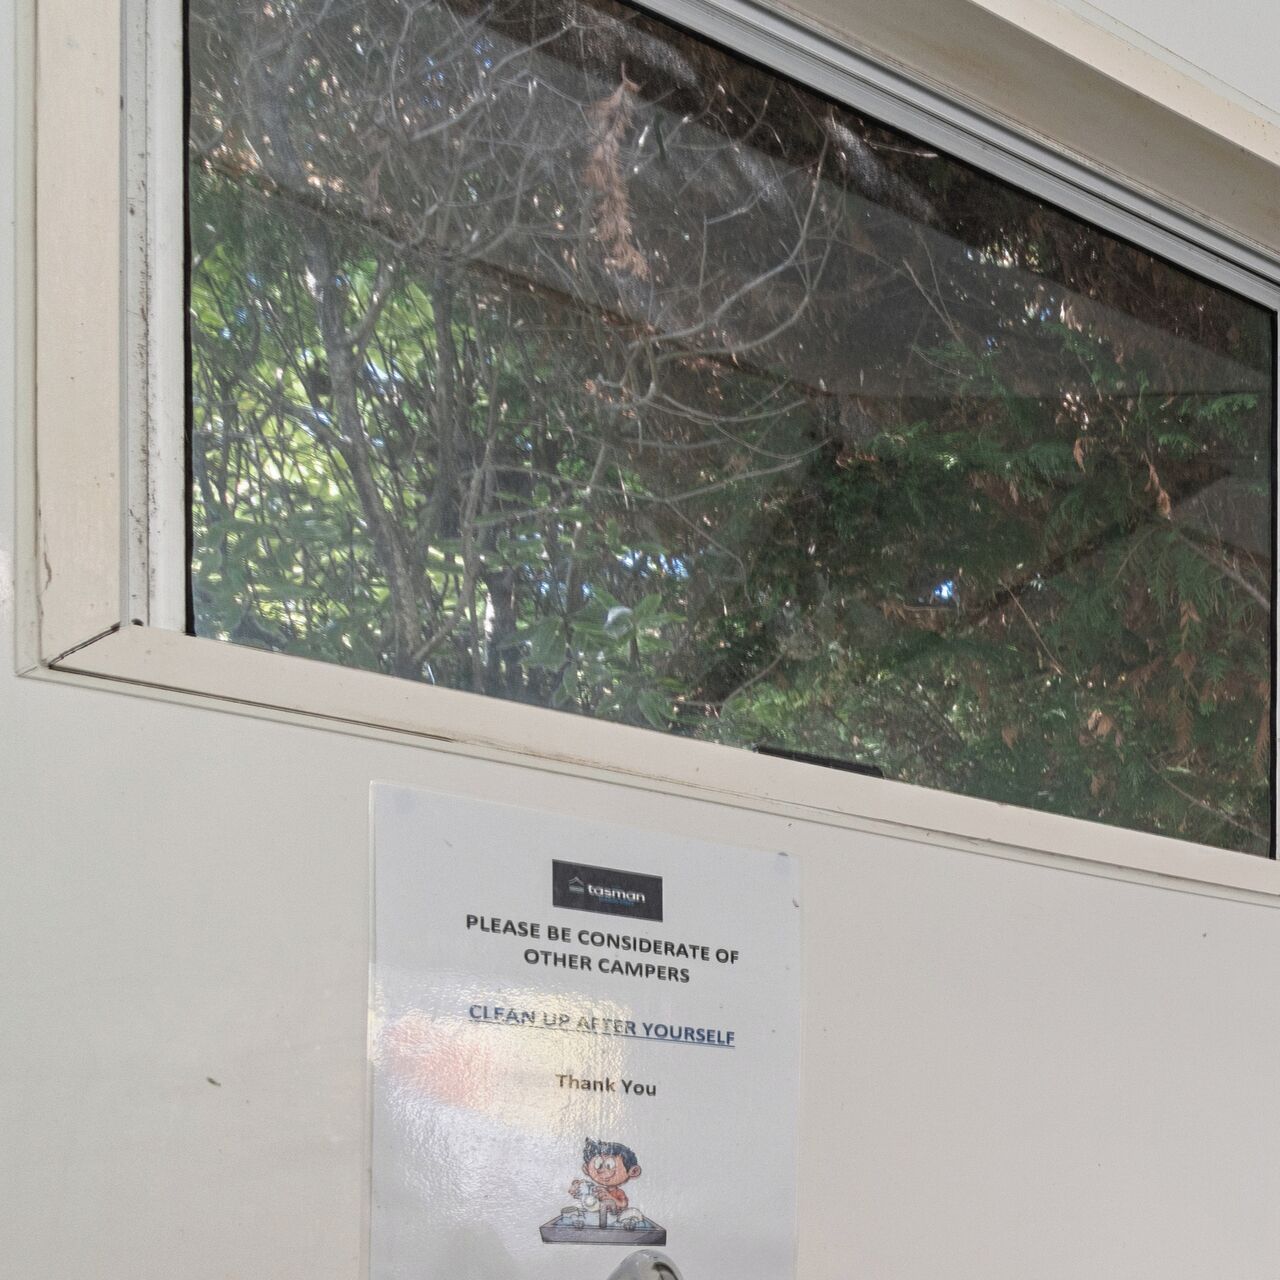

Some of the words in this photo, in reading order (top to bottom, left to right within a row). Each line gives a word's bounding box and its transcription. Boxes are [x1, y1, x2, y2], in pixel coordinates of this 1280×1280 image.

[588, 884, 645, 903] tasman
[466, 914, 540, 939] PLEASE
[547, 925, 572, 943] BE
[577, 929, 710, 961] CONSIDERATE
[715, 948, 739, 964] OF
[524, 948, 592, 972] OTHER
[598, 958, 690, 983] CAMPERS
[469, 1004, 536, 1024] CLEAN
[543, 1012, 570, 1026] UP
[577, 1015, 637, 1035] AFTER
[642, 1022, 736, 1046] YOURSELF
[555, 1073, 617, 1093] Thank
[621, 1079, 657, 1097] You
